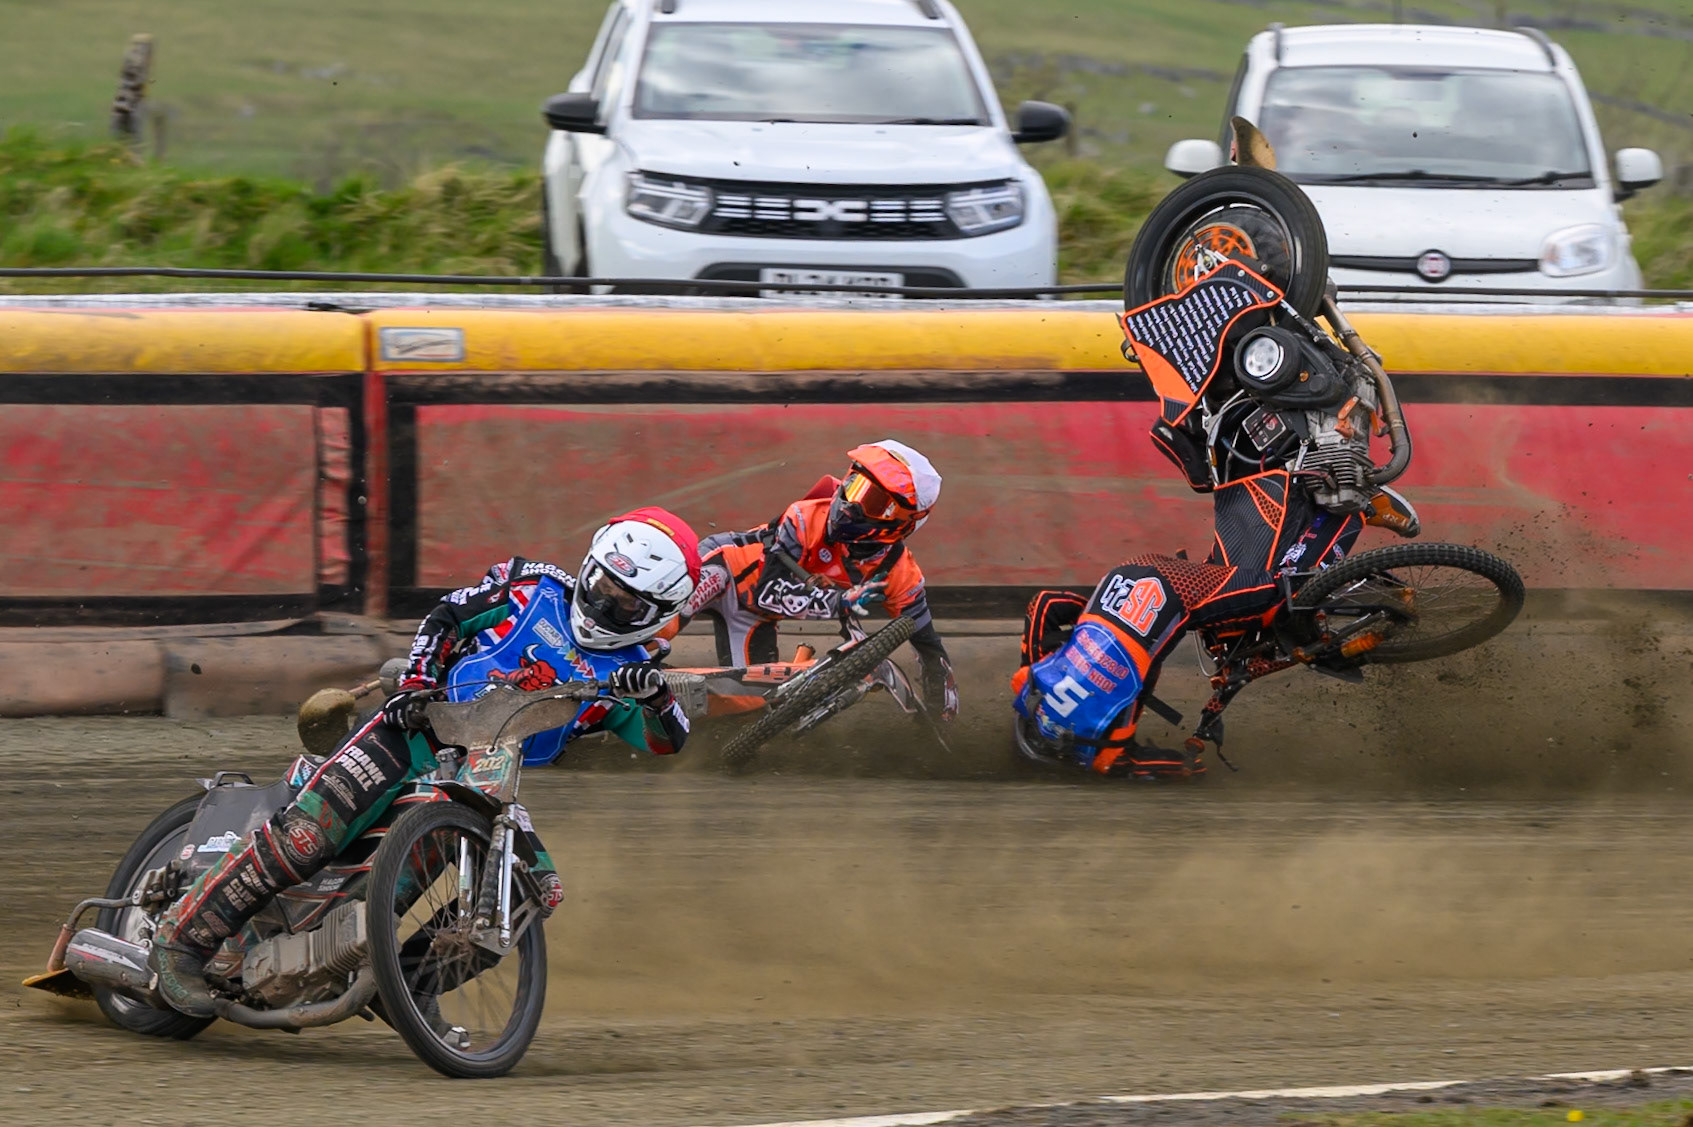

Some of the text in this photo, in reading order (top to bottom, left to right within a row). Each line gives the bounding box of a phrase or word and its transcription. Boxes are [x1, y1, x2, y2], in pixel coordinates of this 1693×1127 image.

[522, 561, 576, 585] HAGON
[1088, 668, 1119, 695] JOHN
[1046, 675, 1090, 718] 5
[335, 756, 376, 793] PRALL
[344, 745, 388, 785] FRANK
[472, 756, 506, 774] 202
[290, 827, 319, 855] STS
